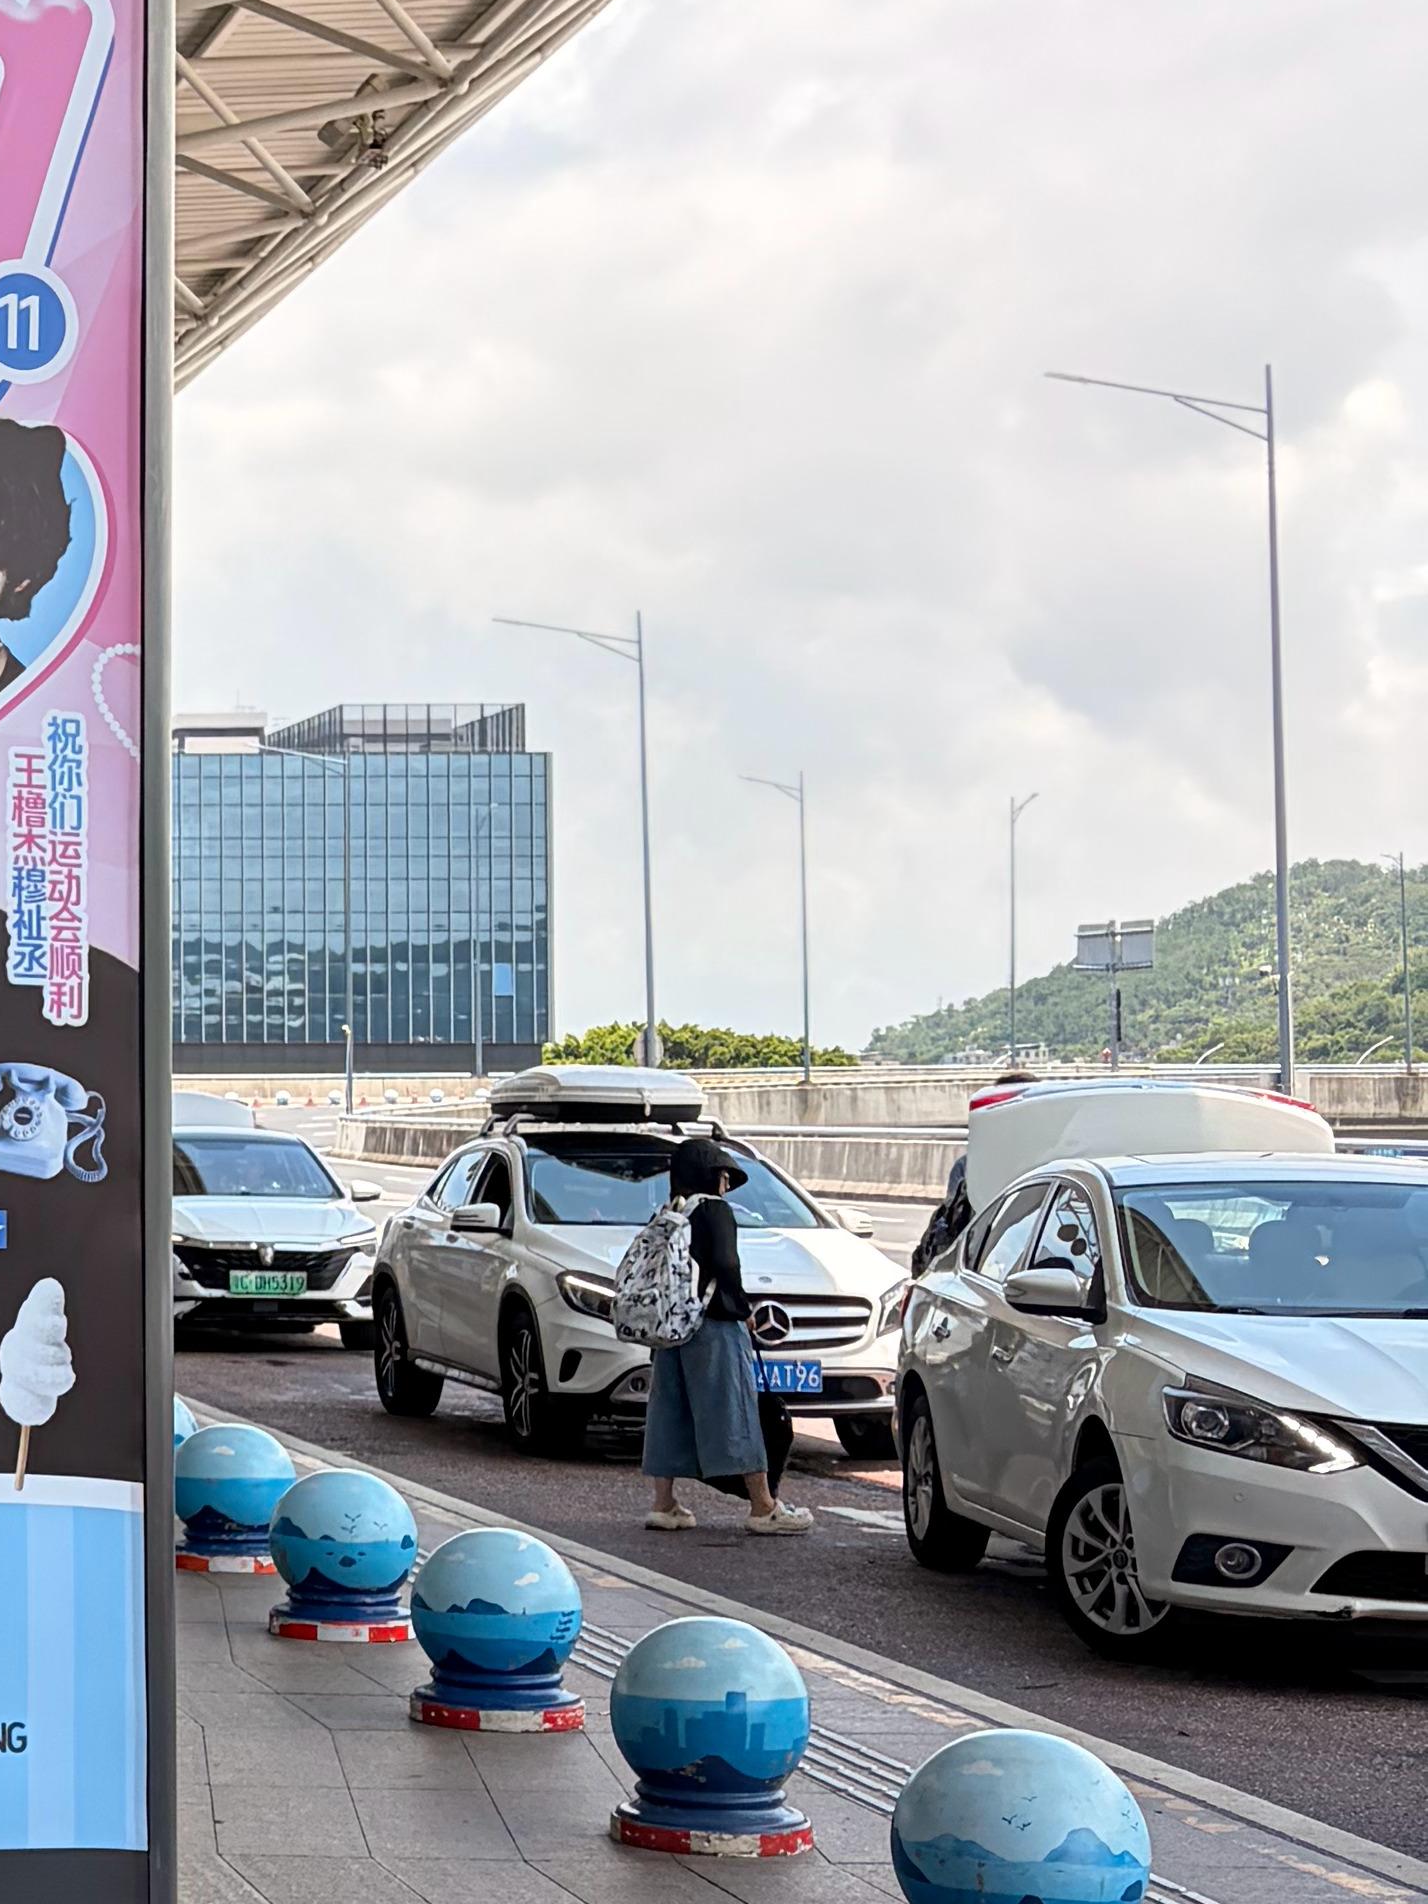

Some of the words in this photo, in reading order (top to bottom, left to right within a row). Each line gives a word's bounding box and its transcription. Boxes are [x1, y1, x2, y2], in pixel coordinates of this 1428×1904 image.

[11, 752, 47, 979] 王橹杰穆祉丞
[47, 715, 83, 1020] 祝你们运动会顺利
